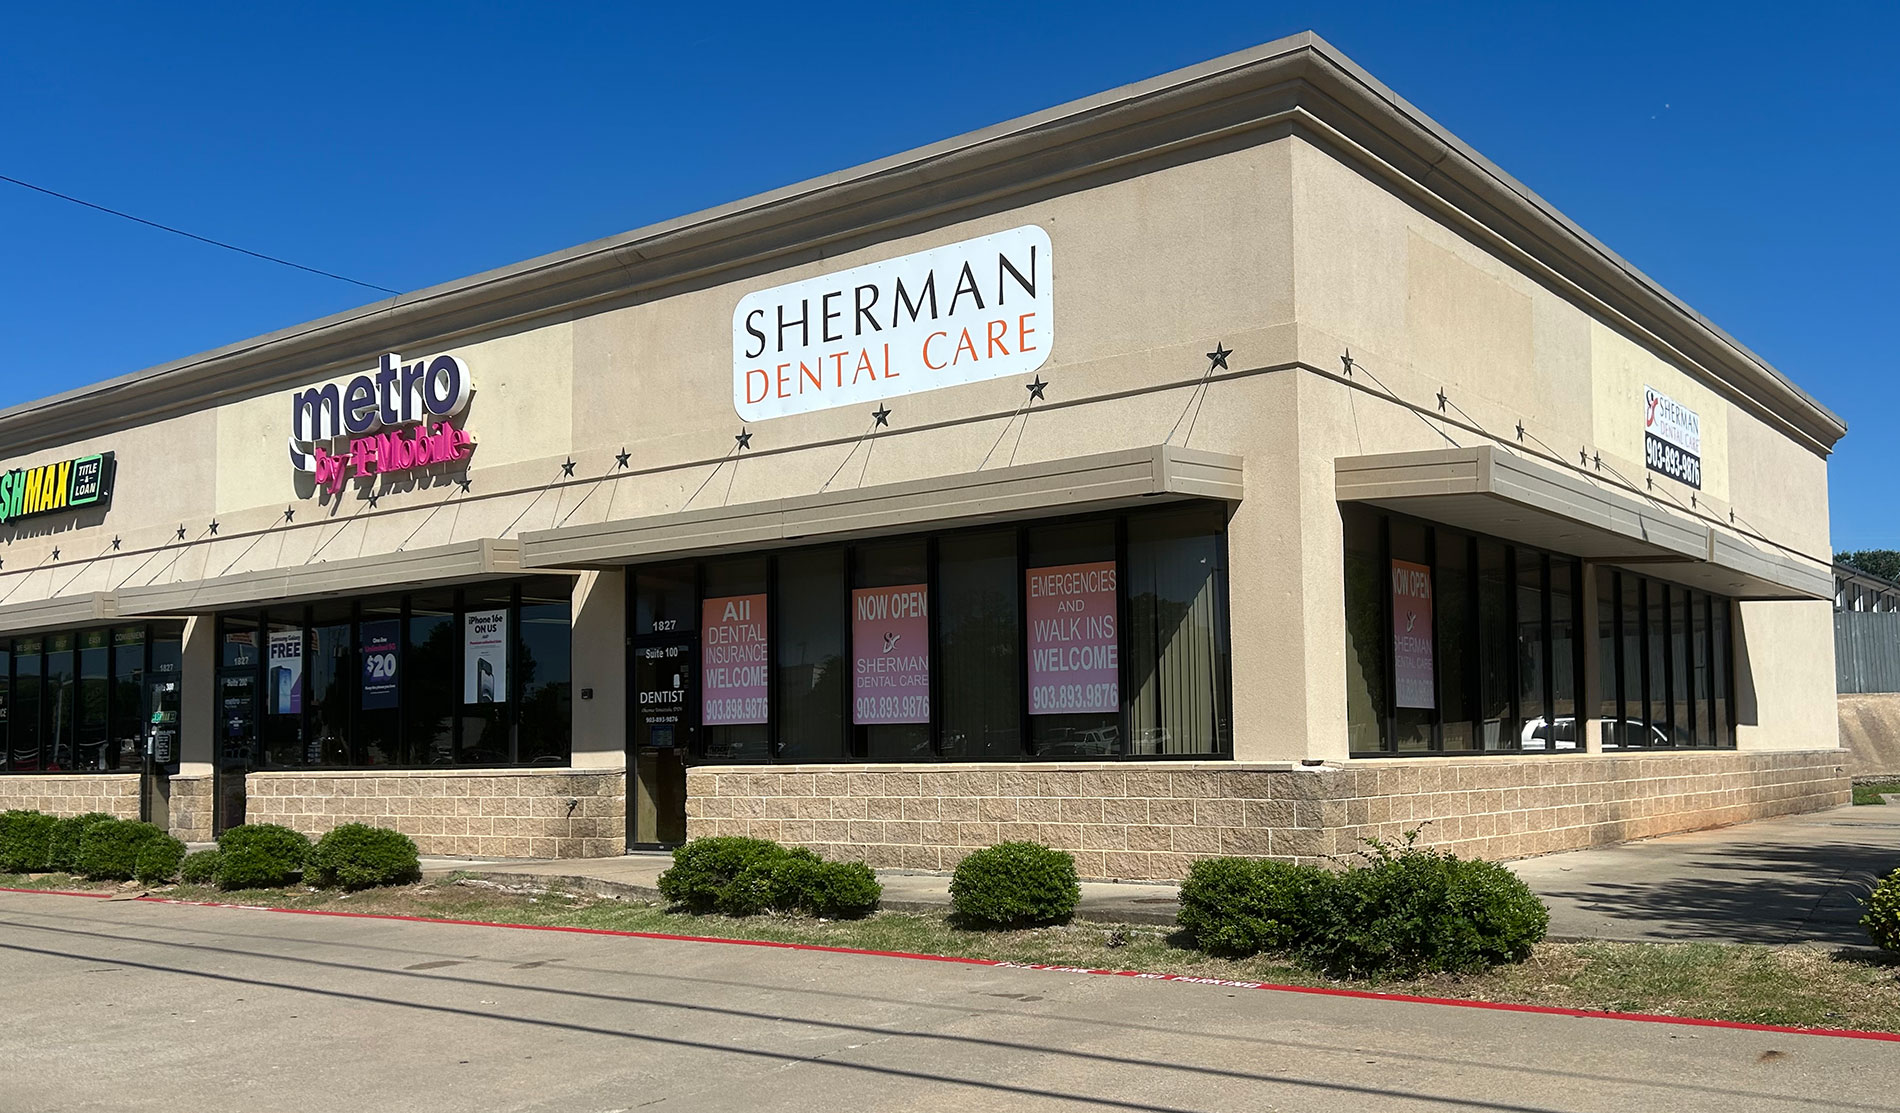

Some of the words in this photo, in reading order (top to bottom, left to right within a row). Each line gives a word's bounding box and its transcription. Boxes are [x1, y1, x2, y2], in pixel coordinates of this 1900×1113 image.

[746, 245, 1036, 358] SHERMAN
[746, 343, 900, 404] DENTAL
[923, 312, 1037, 370] CARE
[293, 353, 468, 441] metro
[1660, 396, 1699, 435] SHERMAN
[1660, 420, 1684, 444] DENTAL
[1684, 433, 1700, 453] CARE
[79, 462, 98, 477] TITLE
[315, 447, 352, 495] by
[1646, 436, 1700, 486] 903-893-9876
[74, 482, 97, 497] LOAN
[1031, 569, 1117, 598] EMERGENCIES
[1410, 570, 1430, 599] OPEN
[722, 600, 751, 622] All
[858, 594, 889, 621] NOW
[891, 591, 928, 619] OPEN
[1057, 599, 1085, 613] AND
[468, 615, 491, 625] iPhone
[491, 614, 503, 623] 16e
[474, 625, 486, 633] ON
[487, 624, 497, 633] US
[652, 620, 677, 631] 1827
[1034, 617, 1082, 643] WALK
[1086, 615, 1115, 640] INS
[708, 623, 767, 645] DENTAL
[234, 656, 249, 666] 1827
[270, 642, 301, 658] FREE
[645, 649, 664, 659] Suite
[665, 647, 678, 657] 100
[705, 643, 768, 664] INSURANCE
[1033, 644, 1118, 673] WELCOME
[159, 664, 174, 672] 1827
[366, 653, 397, 677] $20
[857, 655, 929, 673] SHERMAN
[706, 665, 768, 689] WELCOME
[857, 675, 897, 688] DENTAL
[899, 674, 929, 687] CARE
[640, 690, 685, 704] DENTIST
[856, 695, 930, 719] 903.893.9876
[1033, 682, 1118, 710] 903.893.9876
[706, 697, 768, 721] 903.898.9876
[1170, 976, 1262, 989] PARKING
